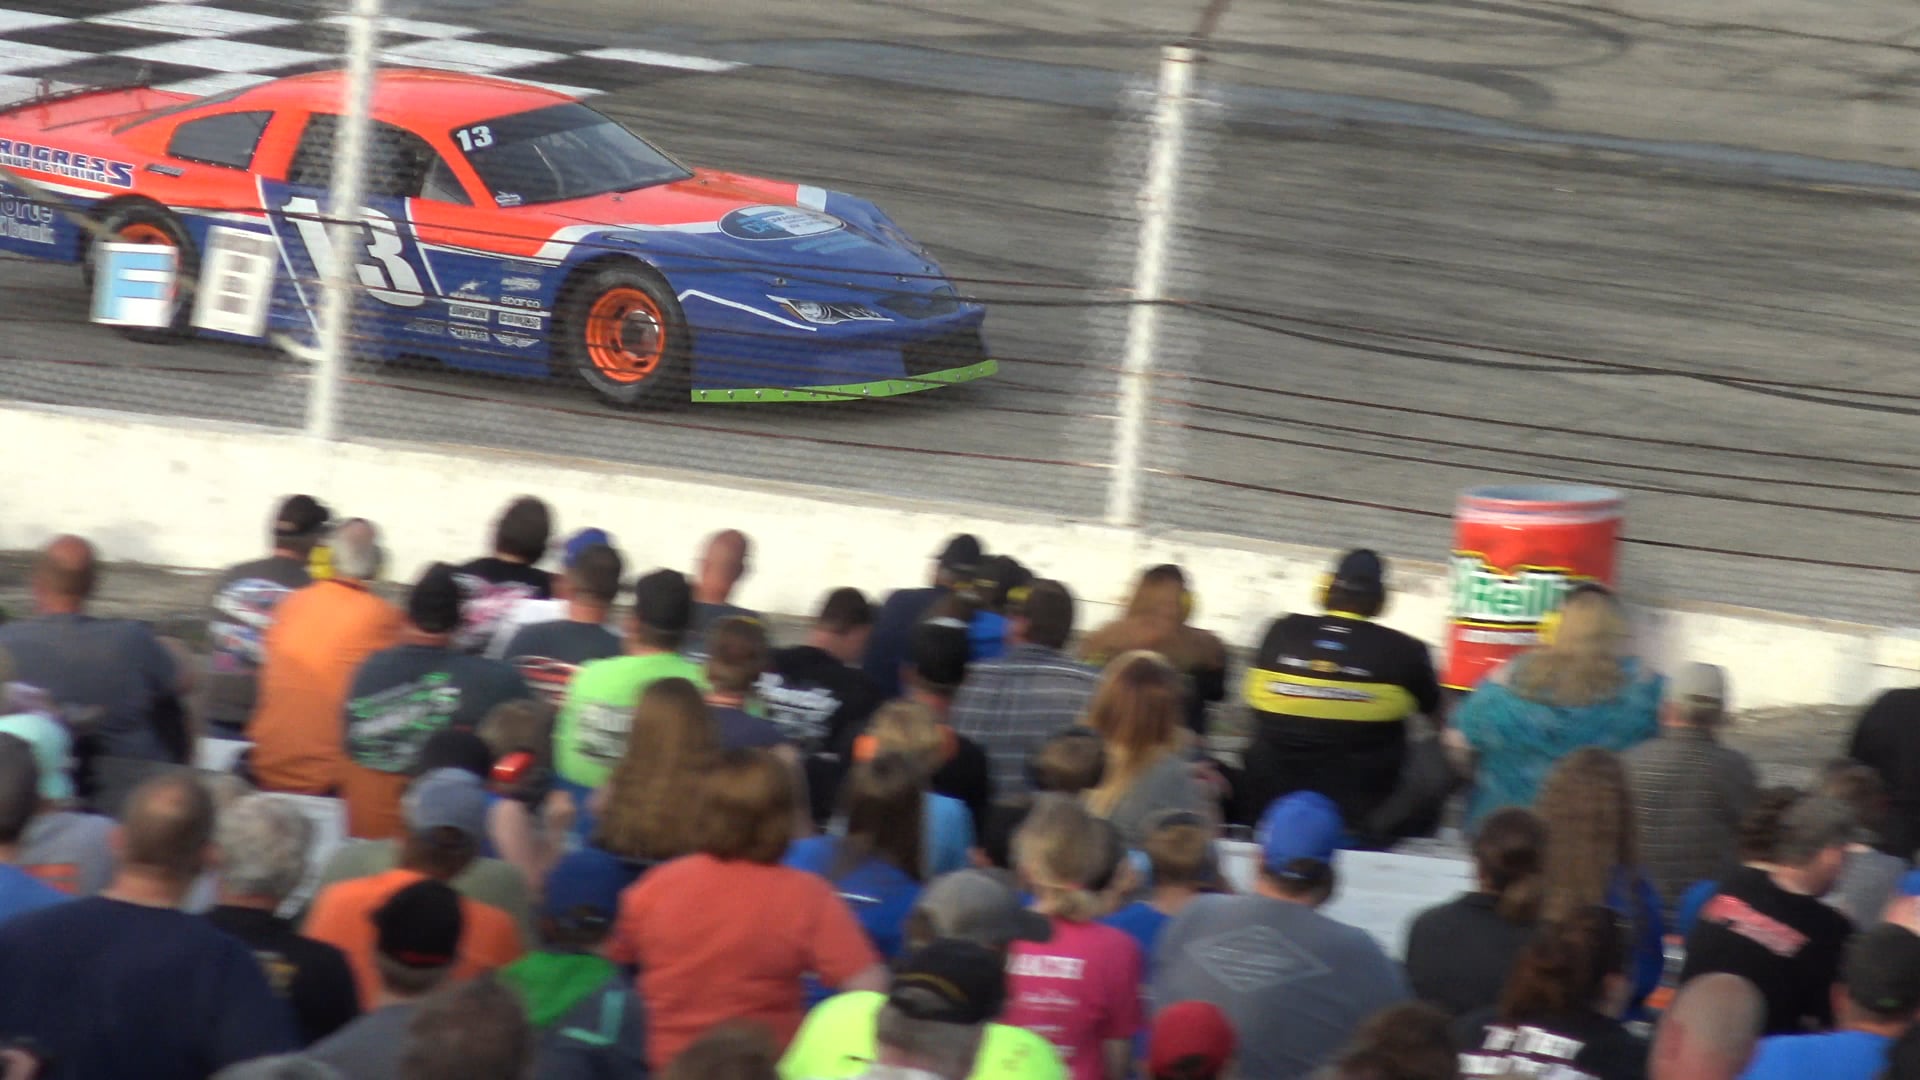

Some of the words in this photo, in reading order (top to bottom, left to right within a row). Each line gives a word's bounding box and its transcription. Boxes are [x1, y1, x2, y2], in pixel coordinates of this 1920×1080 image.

[0, 138, 134, 189] ROGRESS
[456, 125, 494, 151] 13
[281, 197, 424, 307] 13
